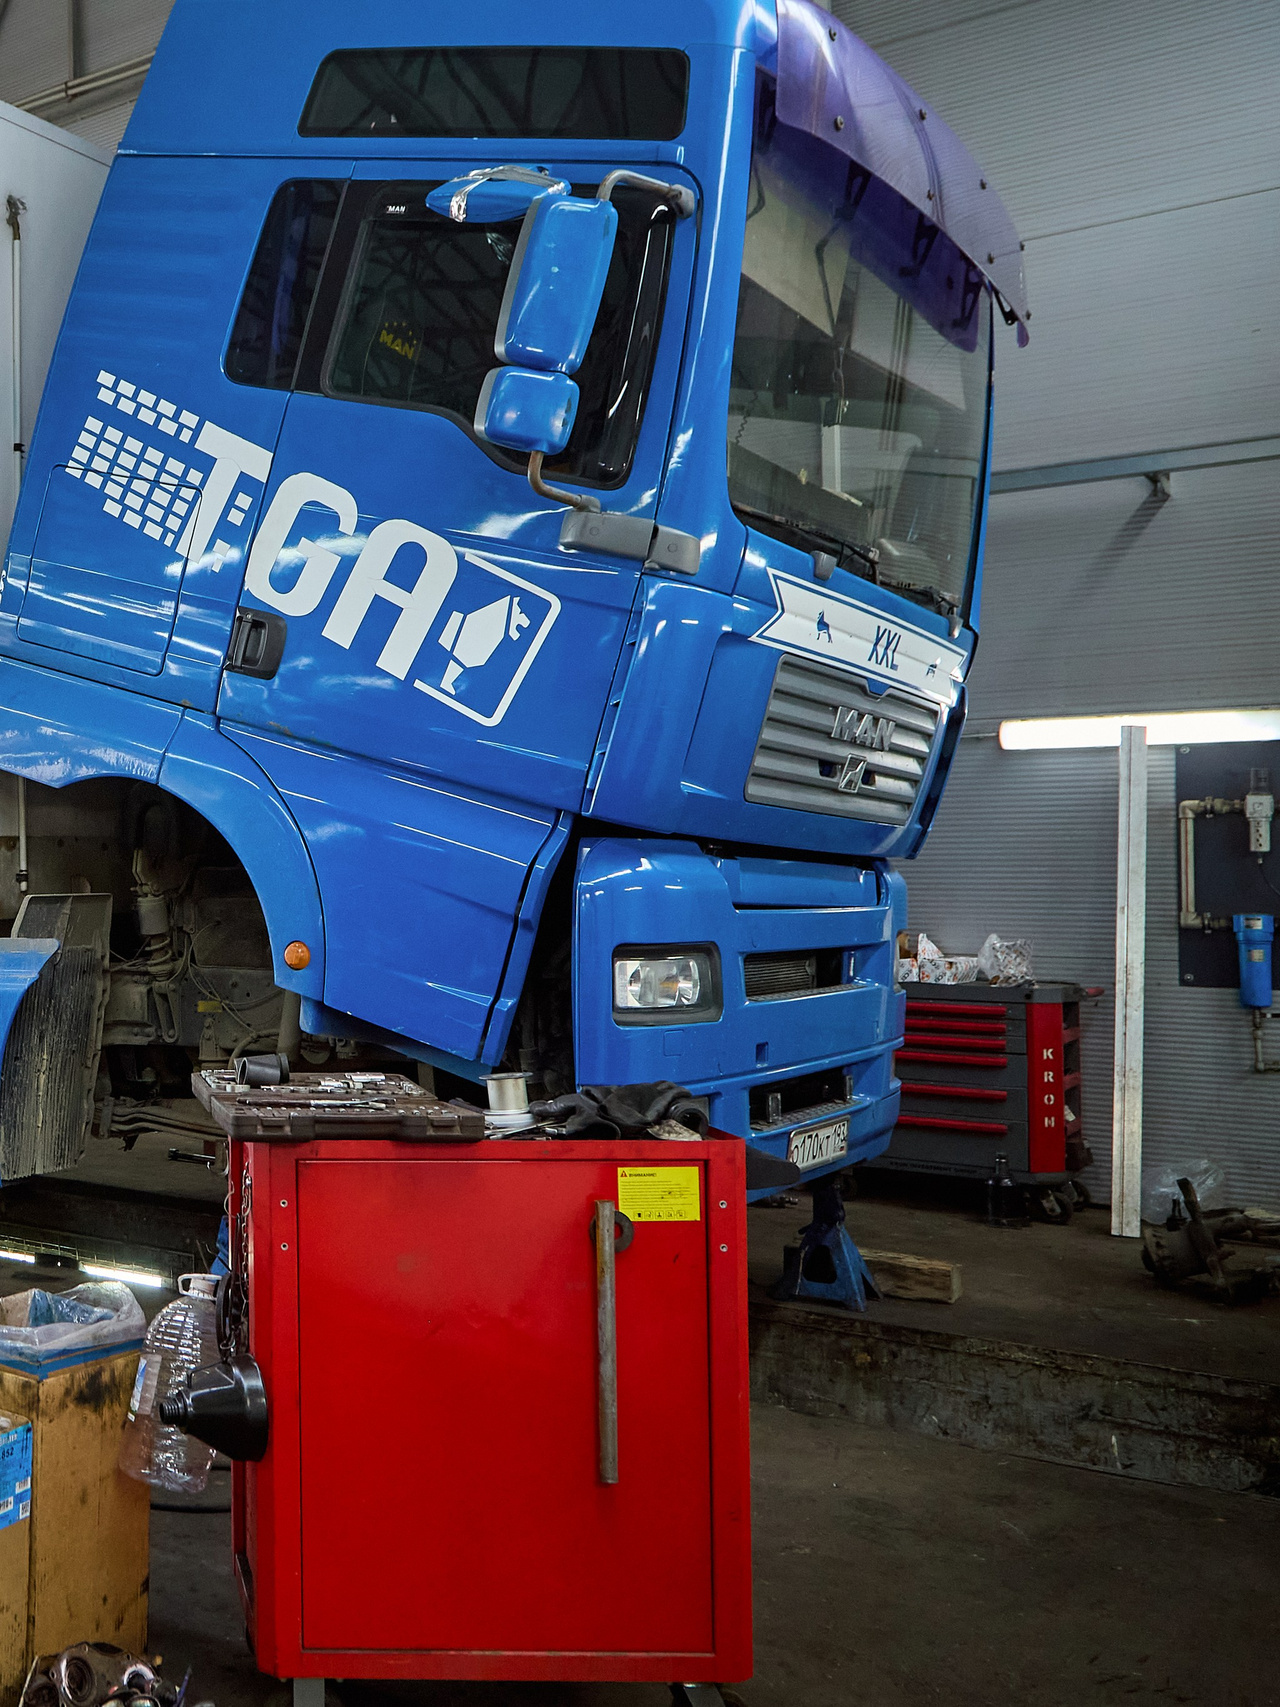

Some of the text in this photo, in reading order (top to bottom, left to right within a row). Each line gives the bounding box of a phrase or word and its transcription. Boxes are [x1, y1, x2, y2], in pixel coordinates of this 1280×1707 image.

[379, 329, 415, 360] MAN
[177, 420, 459, 681] TGA
[867, 625, 902, 671] XXL
[831, 706, 896, 752] MAN
[1043, 1047, 1055, 1128] KRON
